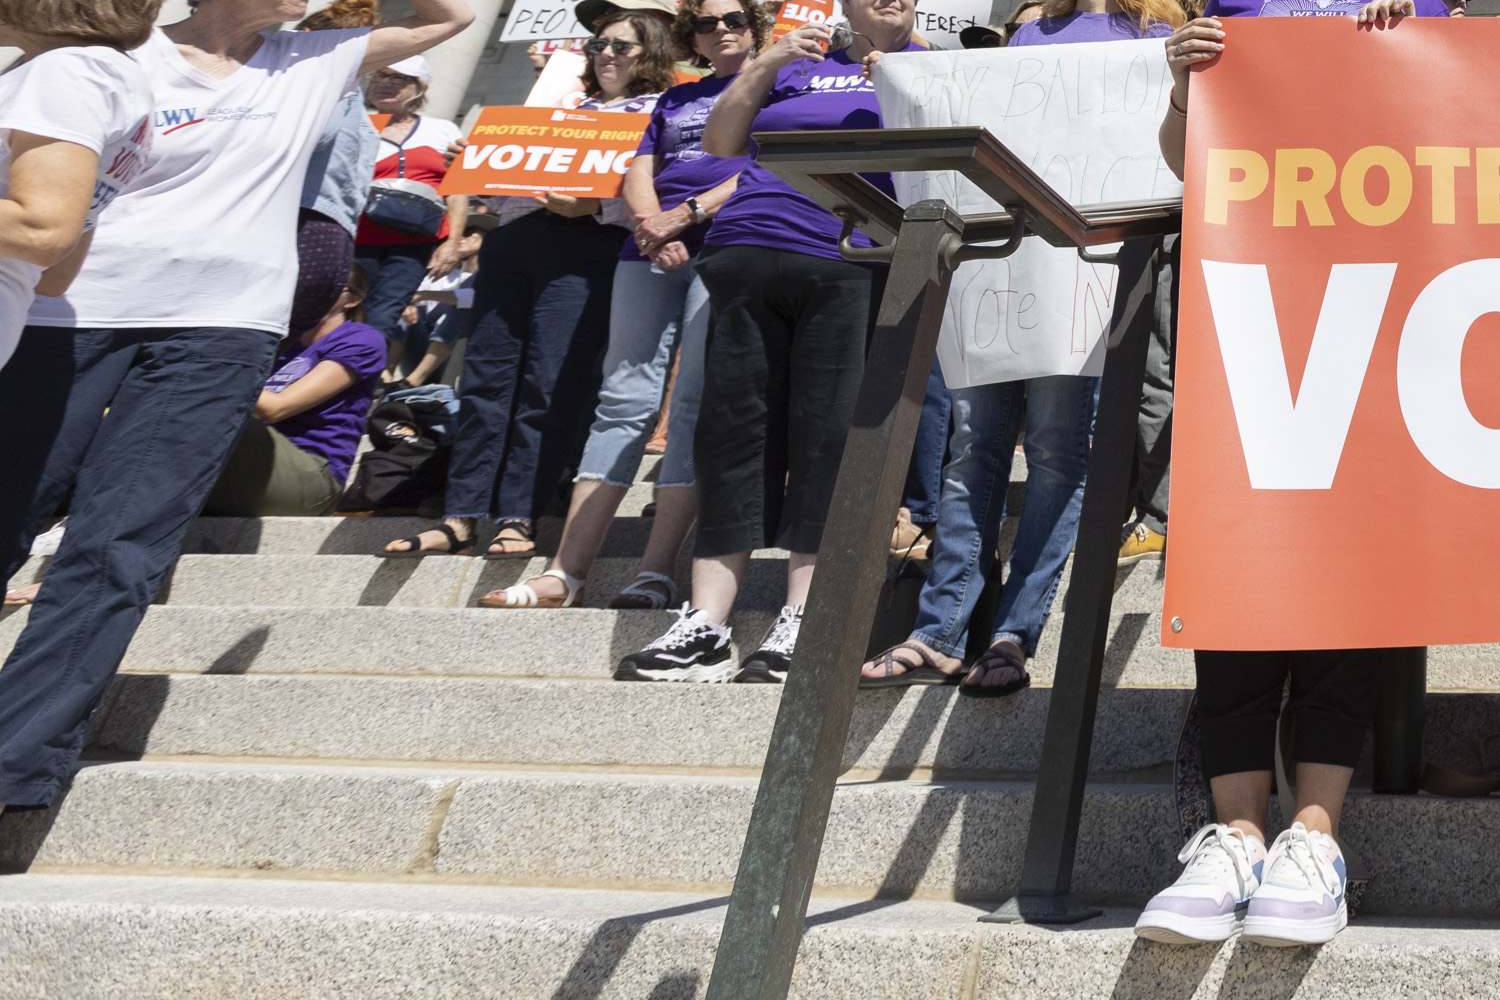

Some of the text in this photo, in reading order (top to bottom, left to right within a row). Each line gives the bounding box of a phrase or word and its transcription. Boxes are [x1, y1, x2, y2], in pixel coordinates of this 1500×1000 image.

[915, 11, 978, 34] TEREST
[155, 107, 196, 127] LWV
[473, 125, 645, 141] PROTECT YOUR RIGHT
[461, 144, 578, 173] VOTE
[1070, 253, 1116, 355] N
